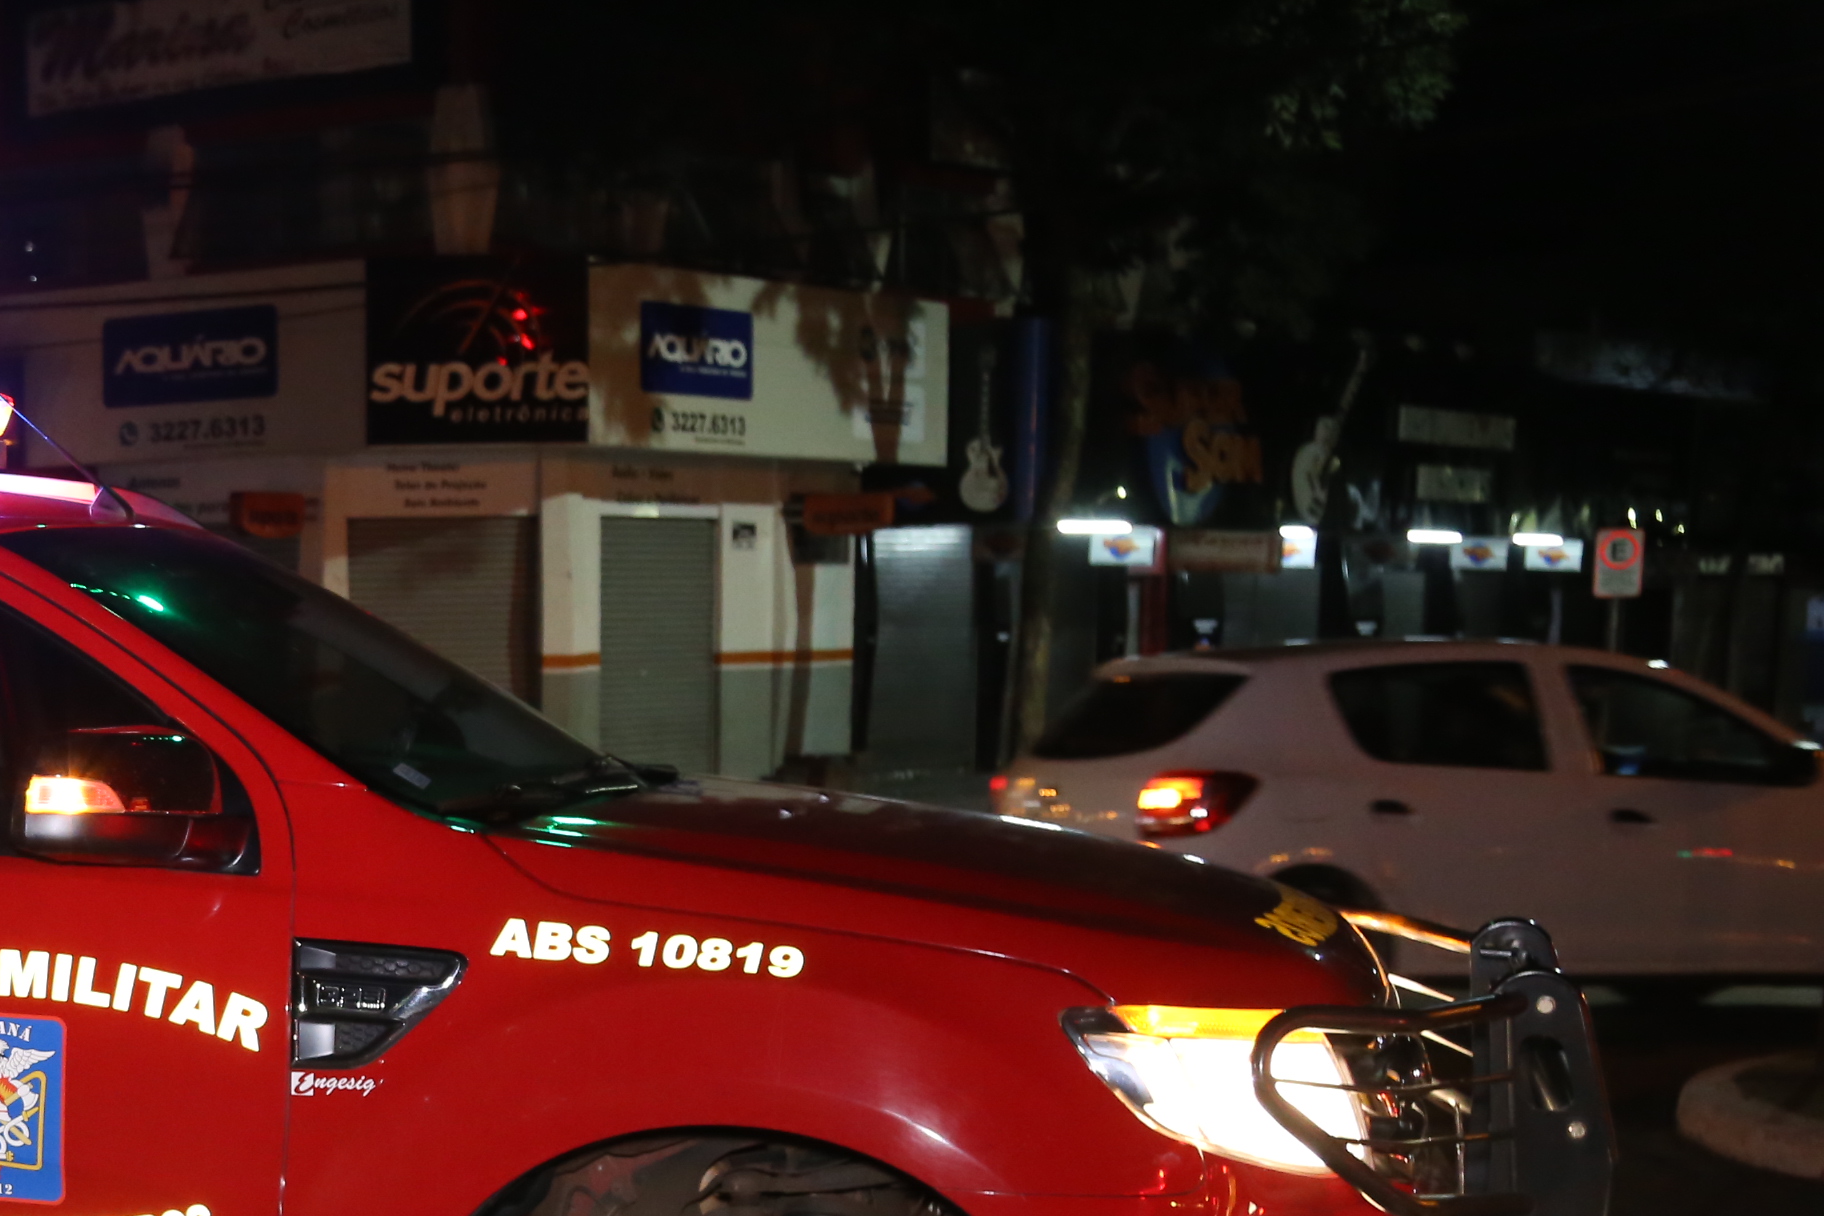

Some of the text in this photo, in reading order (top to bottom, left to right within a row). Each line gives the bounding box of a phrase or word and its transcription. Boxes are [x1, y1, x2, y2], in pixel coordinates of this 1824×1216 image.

[369, 351, 589, 418] suporte
[149, 414, 266, 443] 3227.6313
[672, 411, 746, 437] 3227.6313
[490, 918, 804, 978] ABS 10819
[291, 1072, 376, 1097] Engesig
